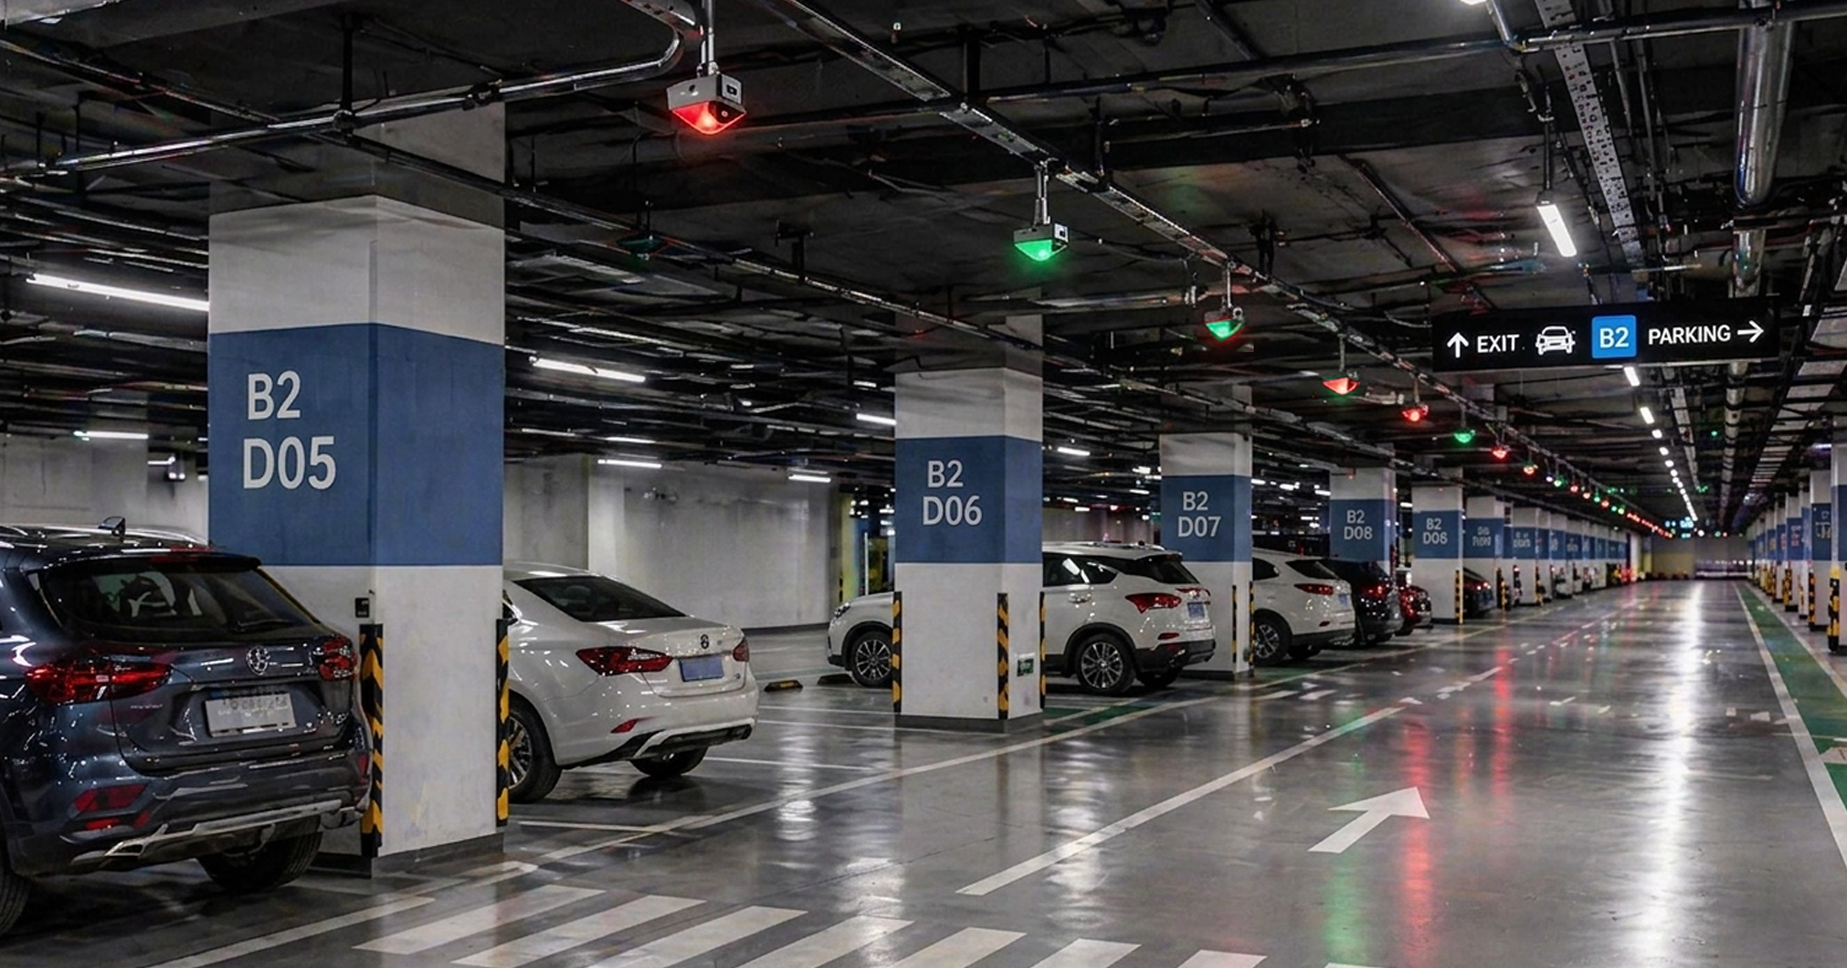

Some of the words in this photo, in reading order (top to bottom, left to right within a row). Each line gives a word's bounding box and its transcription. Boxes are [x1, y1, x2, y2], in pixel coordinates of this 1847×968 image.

[1477, 334, 1520, 353] EXIT
[1600, 326, 1629, 348] B2
[1648, 324, 1732, 345] PARKING
[247, 370, 301, 420] B2
[243, 435, 337, 490] D05
[928, 459, 964, 488] B2
[923, 495, 983, 526] D06
[1183, 490, 1209, 511] B2
[1178, 515, 1222, 537] D07
[1346, 509, 1365, 524] B2
[1426, 517, 1442, 530] B2
[1343, 525, 1373, 540] D08
